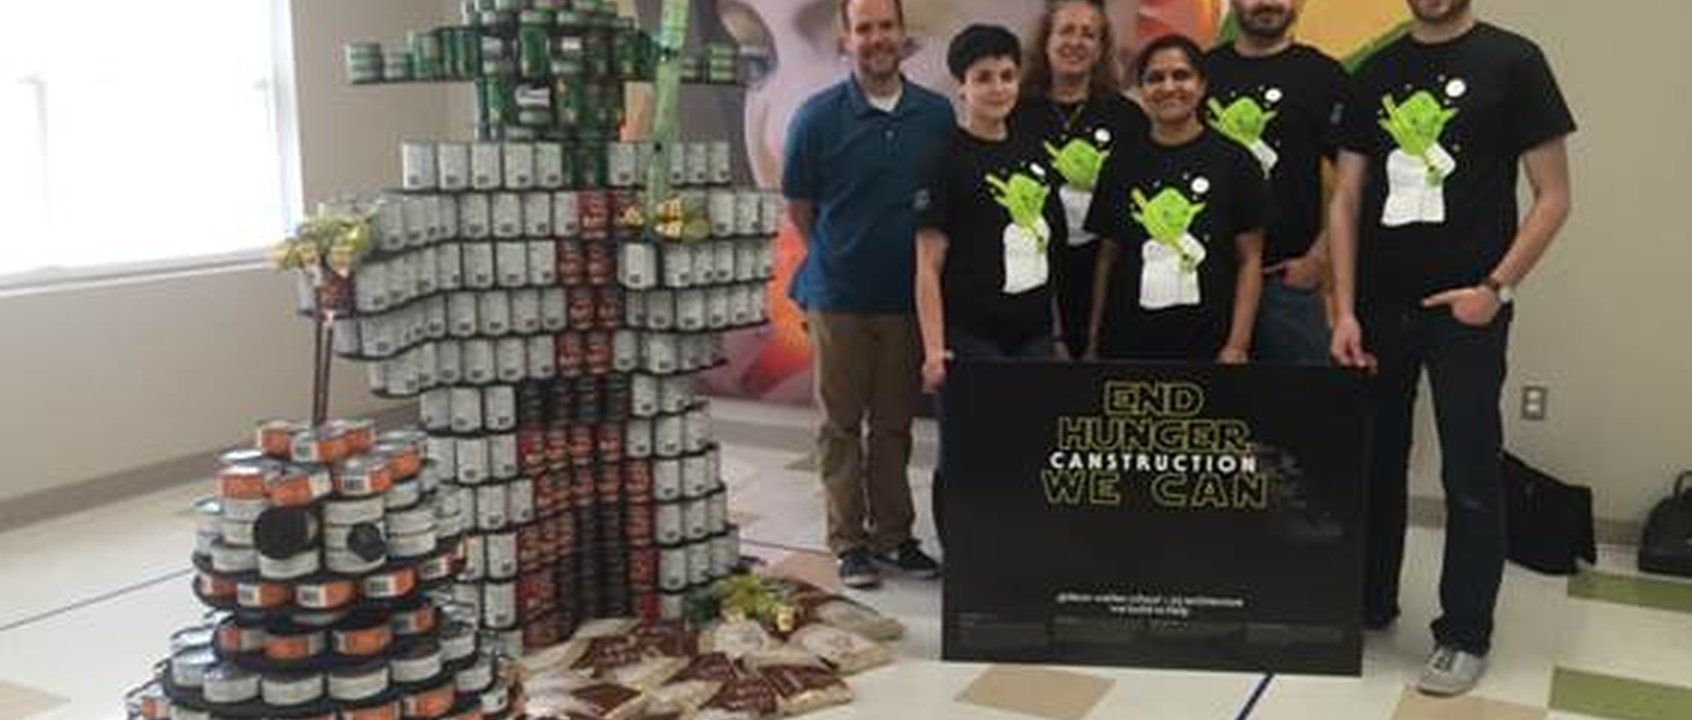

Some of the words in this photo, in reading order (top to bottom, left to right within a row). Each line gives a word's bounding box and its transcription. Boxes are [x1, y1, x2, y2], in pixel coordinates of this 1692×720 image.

[1104, 382, 1204, 416] END
[1058, 417, 1250, 453] HUNGER
[1050, 452, 1256, 472] CANSTRUCTION
[1042, 471, 1120, 504] WE
[1151, 473, 1267, 507] CAN
